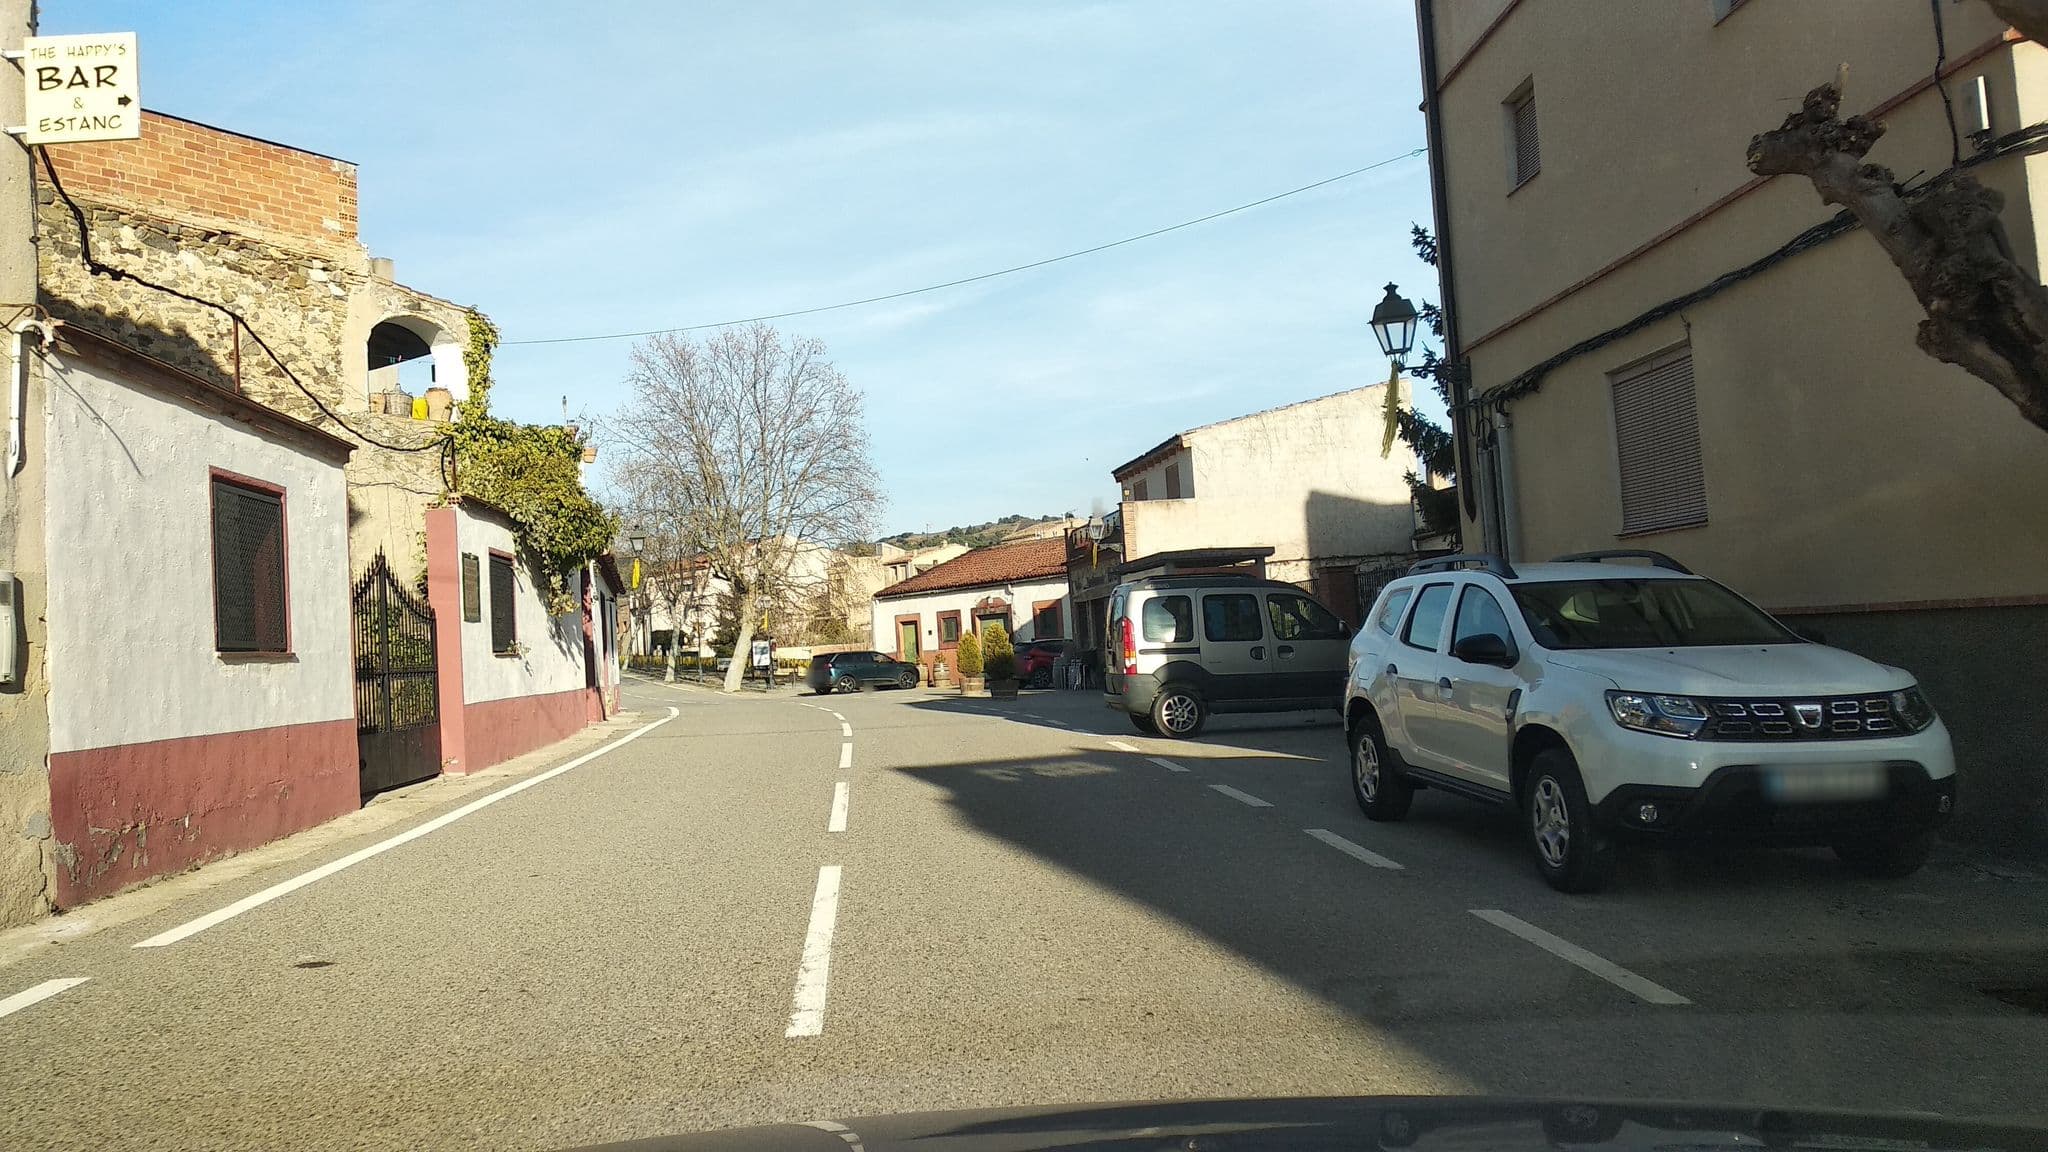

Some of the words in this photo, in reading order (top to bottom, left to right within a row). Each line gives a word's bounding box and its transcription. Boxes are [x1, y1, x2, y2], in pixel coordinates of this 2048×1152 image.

[31, 46, 56, 59] THE
[67, 43, 126, 57] HAPPY'S
[36, 65, 118, 91] BAR
[73, 96, 84, 109] &
[39, 114, 122, 132] ESTANC
